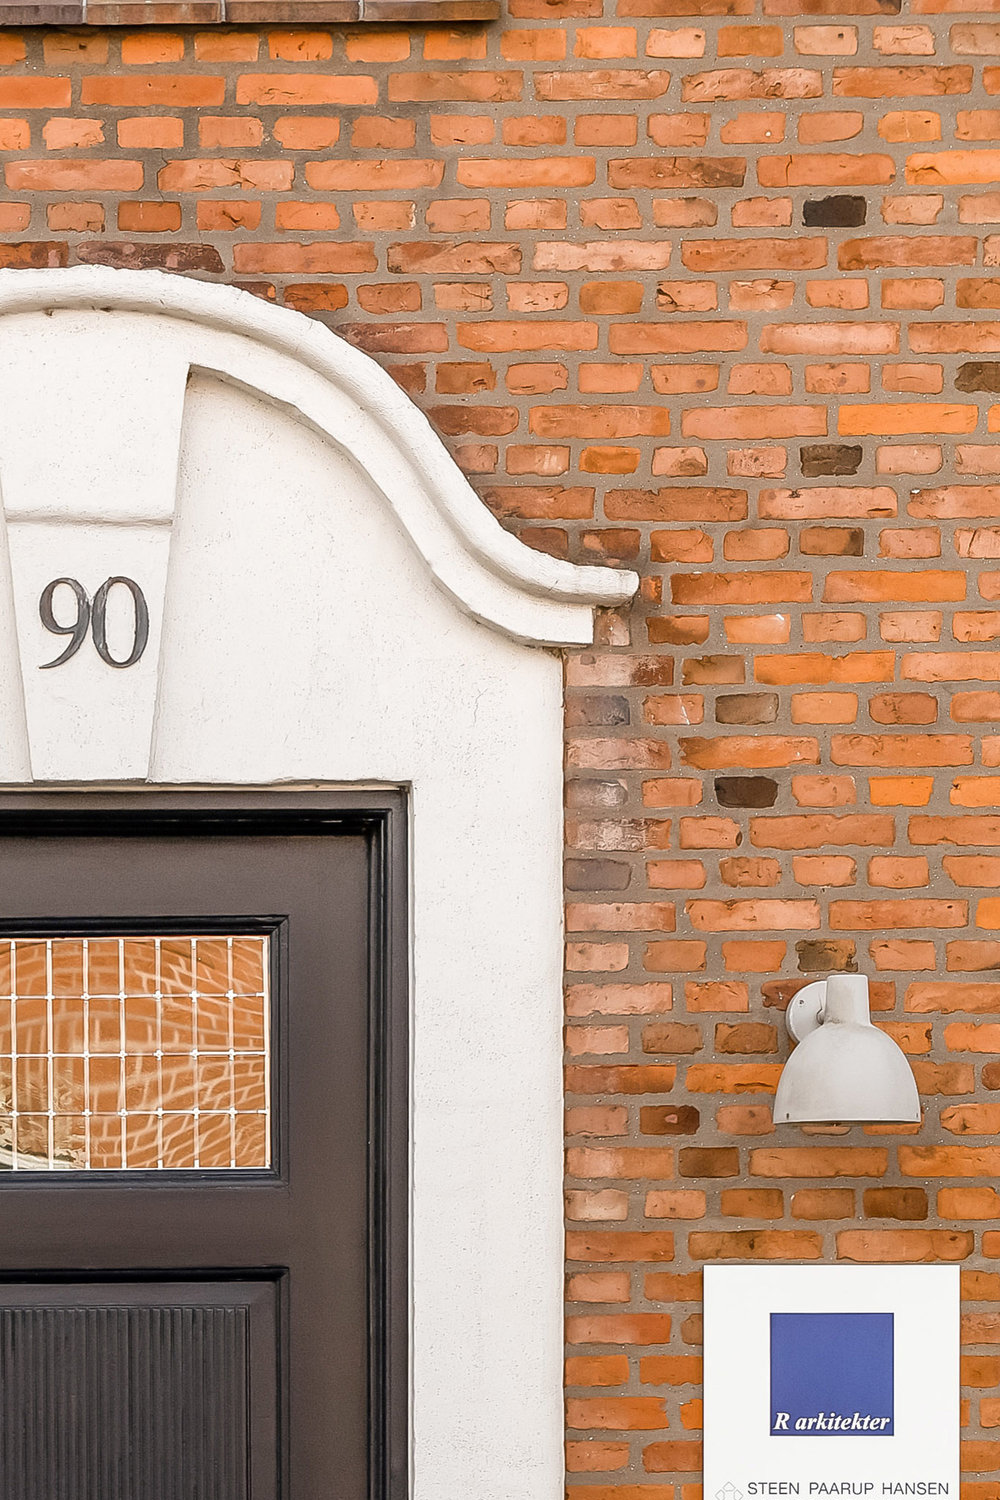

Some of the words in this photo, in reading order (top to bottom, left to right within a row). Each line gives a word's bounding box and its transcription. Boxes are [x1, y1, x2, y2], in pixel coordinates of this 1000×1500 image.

[38, 575, 150, 669] 90
[772, 1412, 790, 1430] R
[795, 1412, 890, 1431] arkitekter
[747, 1481, 800, 1495] STEEN
[809, 1481, 875, 1496] PAARUP
[882, 1481, 949, 1496] HANSEN
